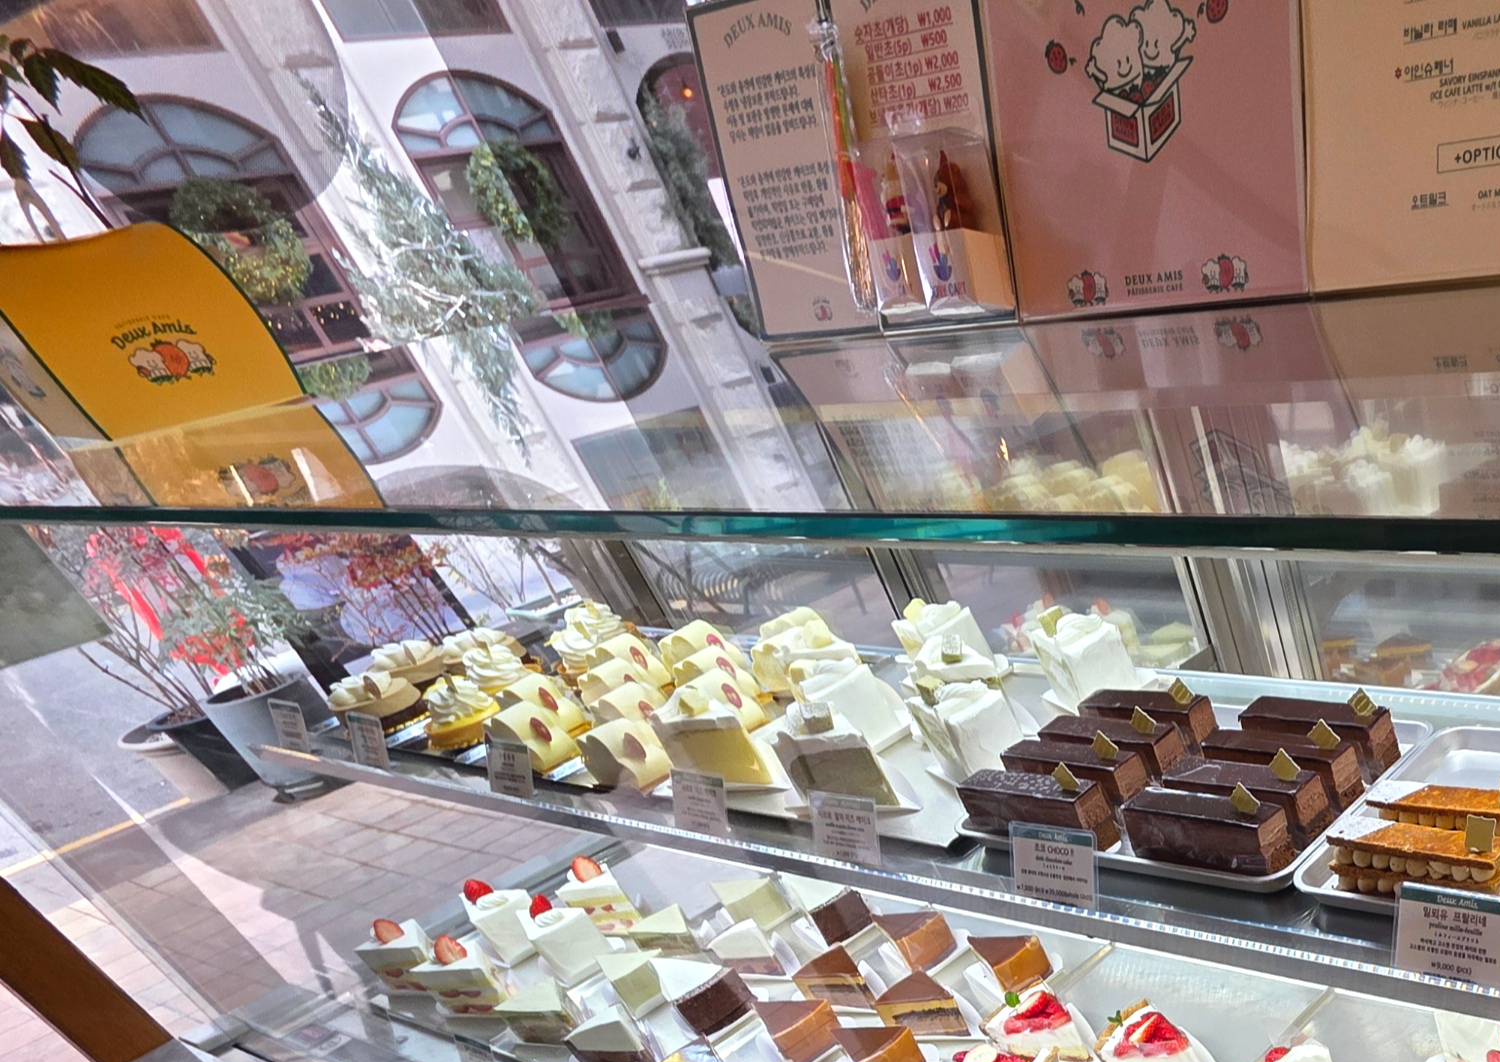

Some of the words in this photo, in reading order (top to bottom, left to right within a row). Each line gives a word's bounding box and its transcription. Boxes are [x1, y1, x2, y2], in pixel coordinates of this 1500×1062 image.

[917, 5, 952, 27] ₩1,000
[723, 13, 755, 48] DEUX
[757, 12, 792, 36] AMIS
[1403, 21, 1433, 41] 바닐라
[1438, 17, 1457, 35] 라떼
[1462, 16, 1492, 30] VANILLA
[864, 38, 913, 60] 일반초(5p)
[920, 29, 948, 48] ₩500
[867, 60, 923, 83] 곰돌이초(1p)
[924, 50, 959, 71] ₩2,000
[870, 82, 917, 105] 산타초(1p)
[927, 72, 962, 93] ₩2,500
[1439, 74, 1466, 88] SAVORY
[1430, 89, 1443, 102] (ICE
[1444, 86, 1462, 98] CAFE
[1463, 83, 1484, 96] LATTE
[1478, 190, 1492, 200] OAT
[1125, 273, 1152, 286] DEUX
[1157, 270, 1183, 283] AMIS
[111, 326, 152, 350] Deux
[151, 319, 197, 335] Amis
[1437, 895, 1458, 906] Deux
[1458, 899, 1478, 909] Amis
[1429, 922, 1448, 931] praline
[1449, 925, 1482, 936] mille-feuille
[1456, 964, 1472, 975] (pcs)
